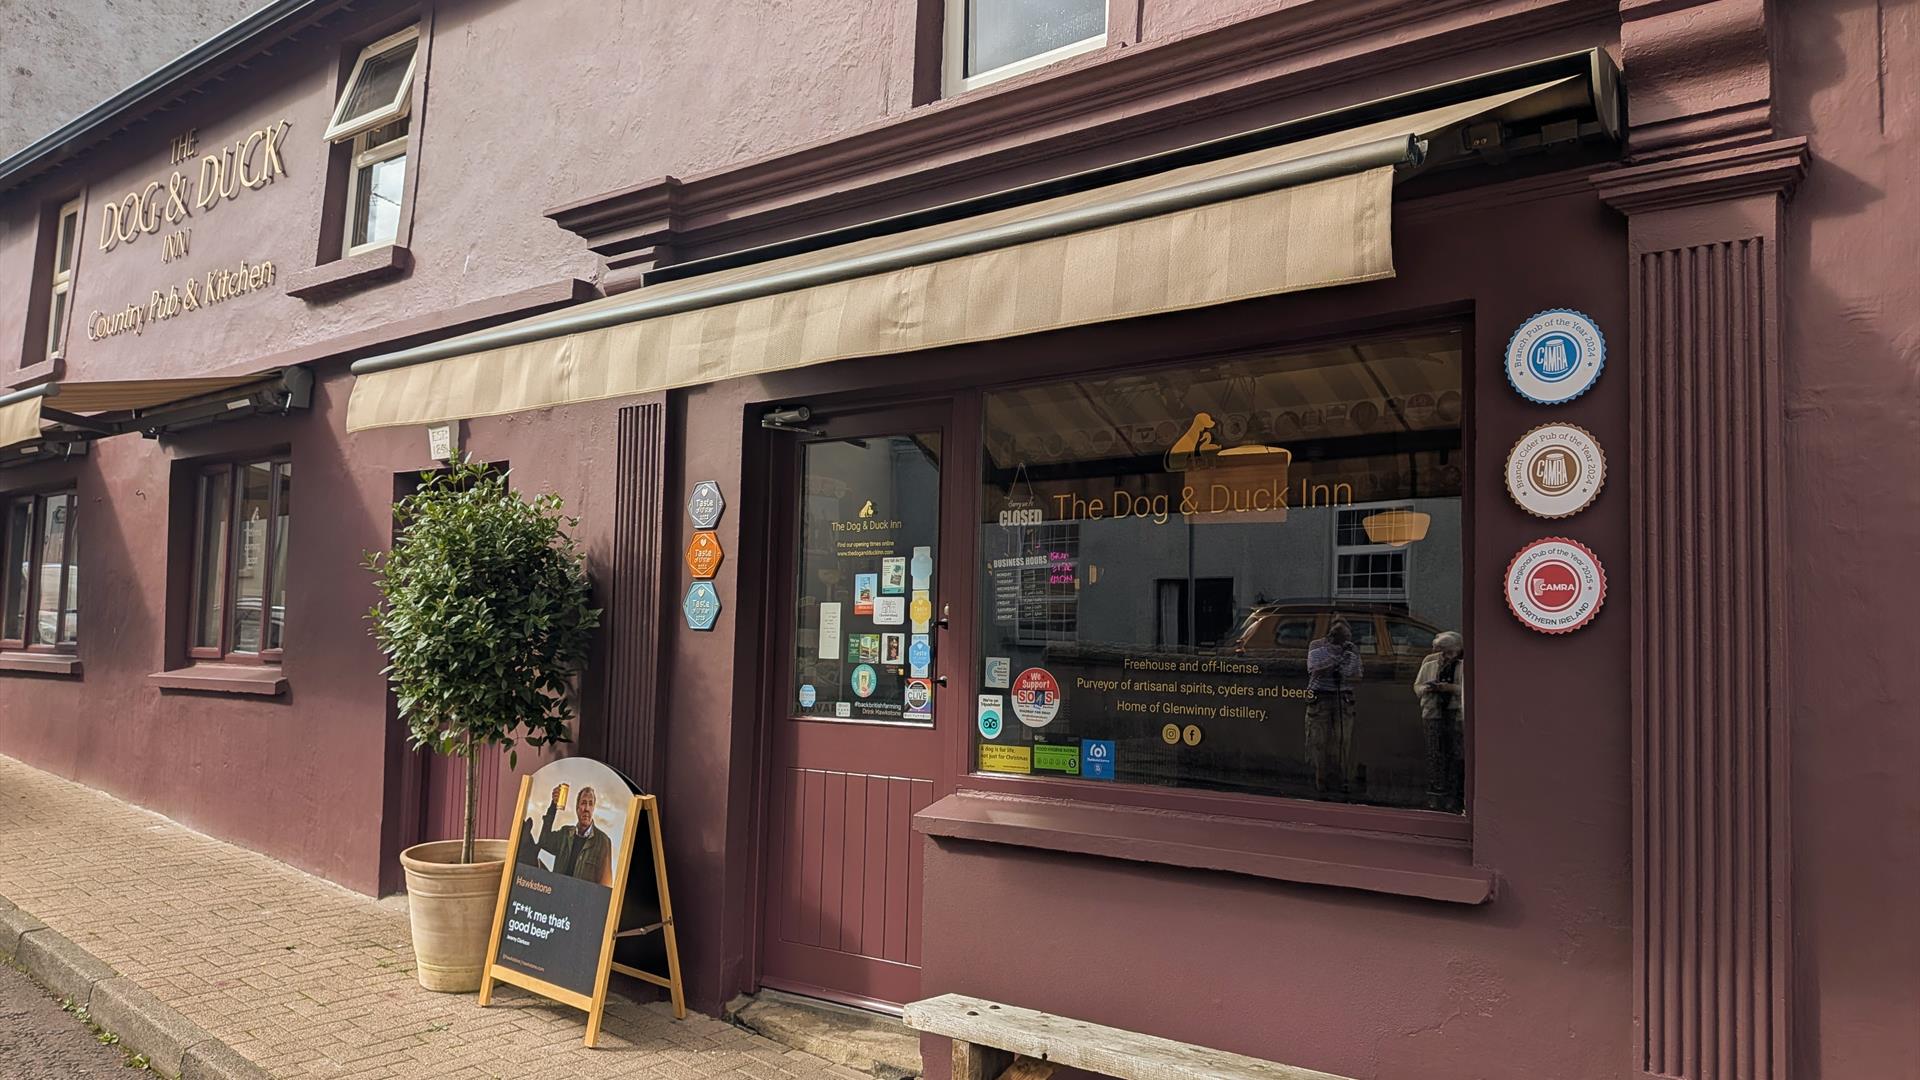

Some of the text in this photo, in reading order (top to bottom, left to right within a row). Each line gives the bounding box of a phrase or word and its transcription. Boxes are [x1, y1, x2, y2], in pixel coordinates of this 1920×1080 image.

[170, 128, 197, 164] THE
[99, 119, 286, 249] DOG & DUCK
[161, 230, 188, 263] INN
[88, 260, 272, 340] Country Pub & Kitchen
[1514, 318, 1596, 368] Branch Pub of the Year 2024
[1536, 343, 1568, 373] CAMRA
[1540, 432, 1557, 442] Pub
[1569, 435, 1582, 447] the
[1520, 439, 1539, 458] Cider
[1581, 444, 1593, 462] Year
[1516, 459, 1524, 489] Branch
[1536, 457, 1568, 487] CAMRA
[1586, 464, 1596, 485] 2024
[696, 499, 714, 507] Taste
[1053, 478, 1352, 525] The Dog & Duck Inn
[832, 520, 902, 532] The Dog & Duck Inn
[999, 509, 1042, 526] CLOSED
[695, 549, 712, 557] Taste
[993, 555, 1048, 568] BUSINESS HOURS
[1513, 557, 1533, 585] Regional
[1531, 550, 1547, 560] Pub
[1557, 549, 1569, 557] the
[1570, 552, 1584, 565] Year
[1582, 566, 1594, 584] 2025
[692, 600, 710, 608] Taste
[1518, 601, 1589, 625] NORTHERN IRELAND
[1030, 672, 1041, 680] We
[1124, 658, 1262, 674] Freehouse and off-license.
[1022, 680, 1050, 690] Support
[1077, 678, 1318, 699] Purveyor of artisanal spirits, cyders and beers.
[854, 701, 902, 711] #backbritishfarming
[908, 692, 927, 700] CLIVE
[1116, 700, 1269, 721] Home of Glenwinny distillery.
[516, 875, 552, 895] Hawkstone
[508, 919, 555, 940] good beer"
[533, 911, 548, 923] me
[549, 913, 571, 931] that's
